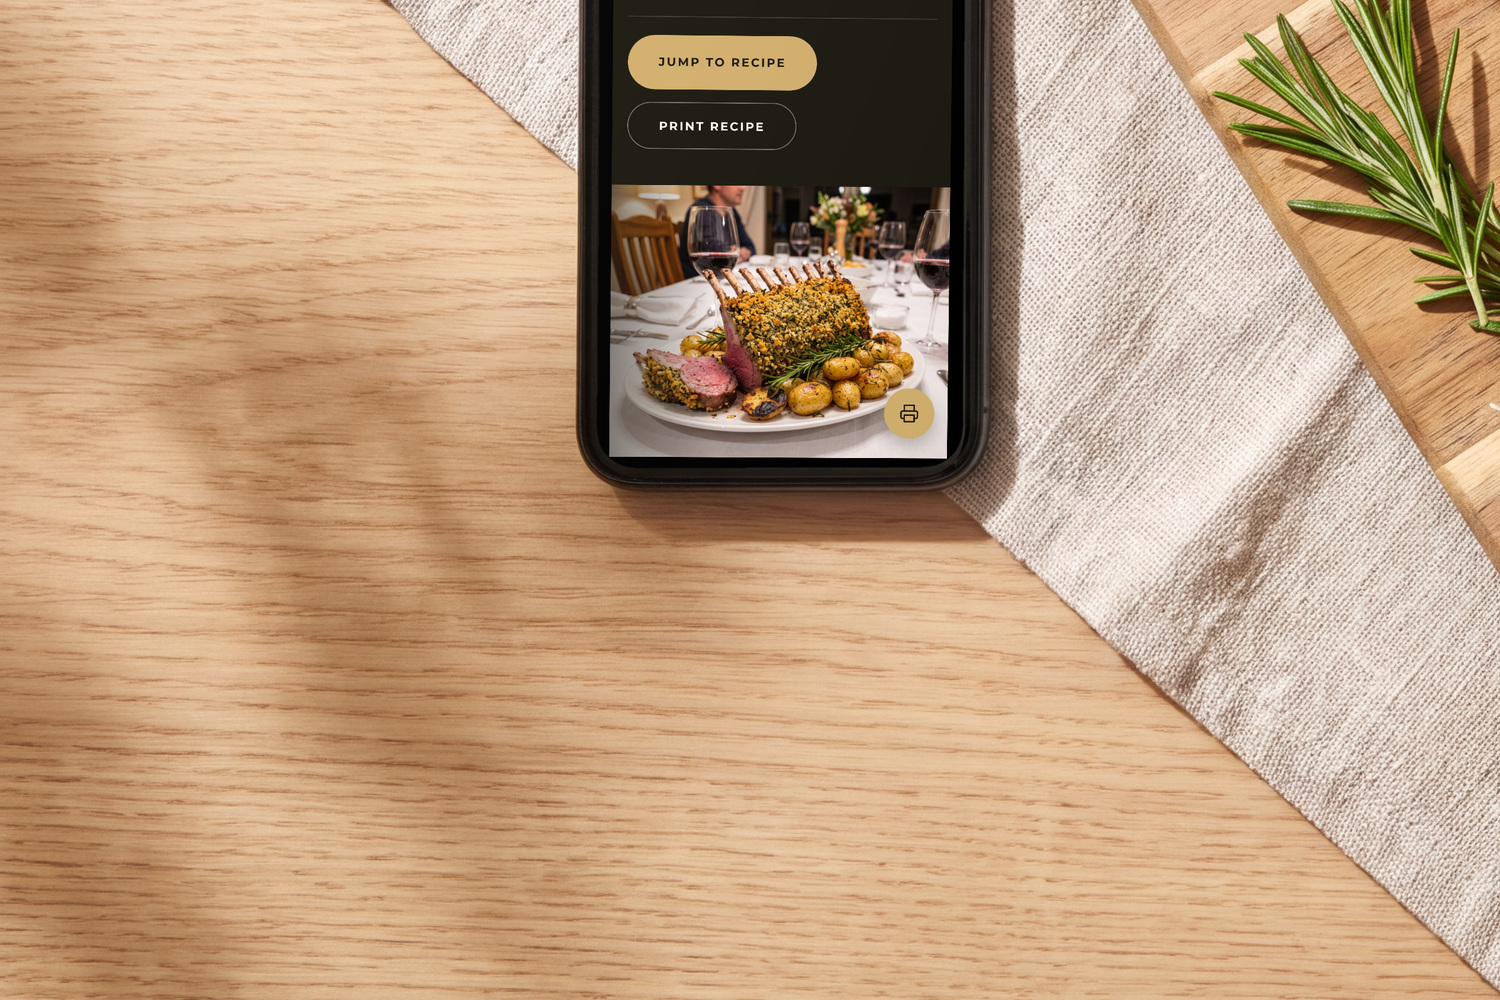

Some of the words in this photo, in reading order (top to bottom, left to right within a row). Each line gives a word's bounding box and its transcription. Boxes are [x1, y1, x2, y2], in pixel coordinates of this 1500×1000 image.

[658, 56, 700, 67] JUMP
[705, 57, 725, 68] TO
[731, 57, 785, 68] RECIPE
[659, 121, 704, 132] PRINT
[710, 121, 764, 132] RECIPE
